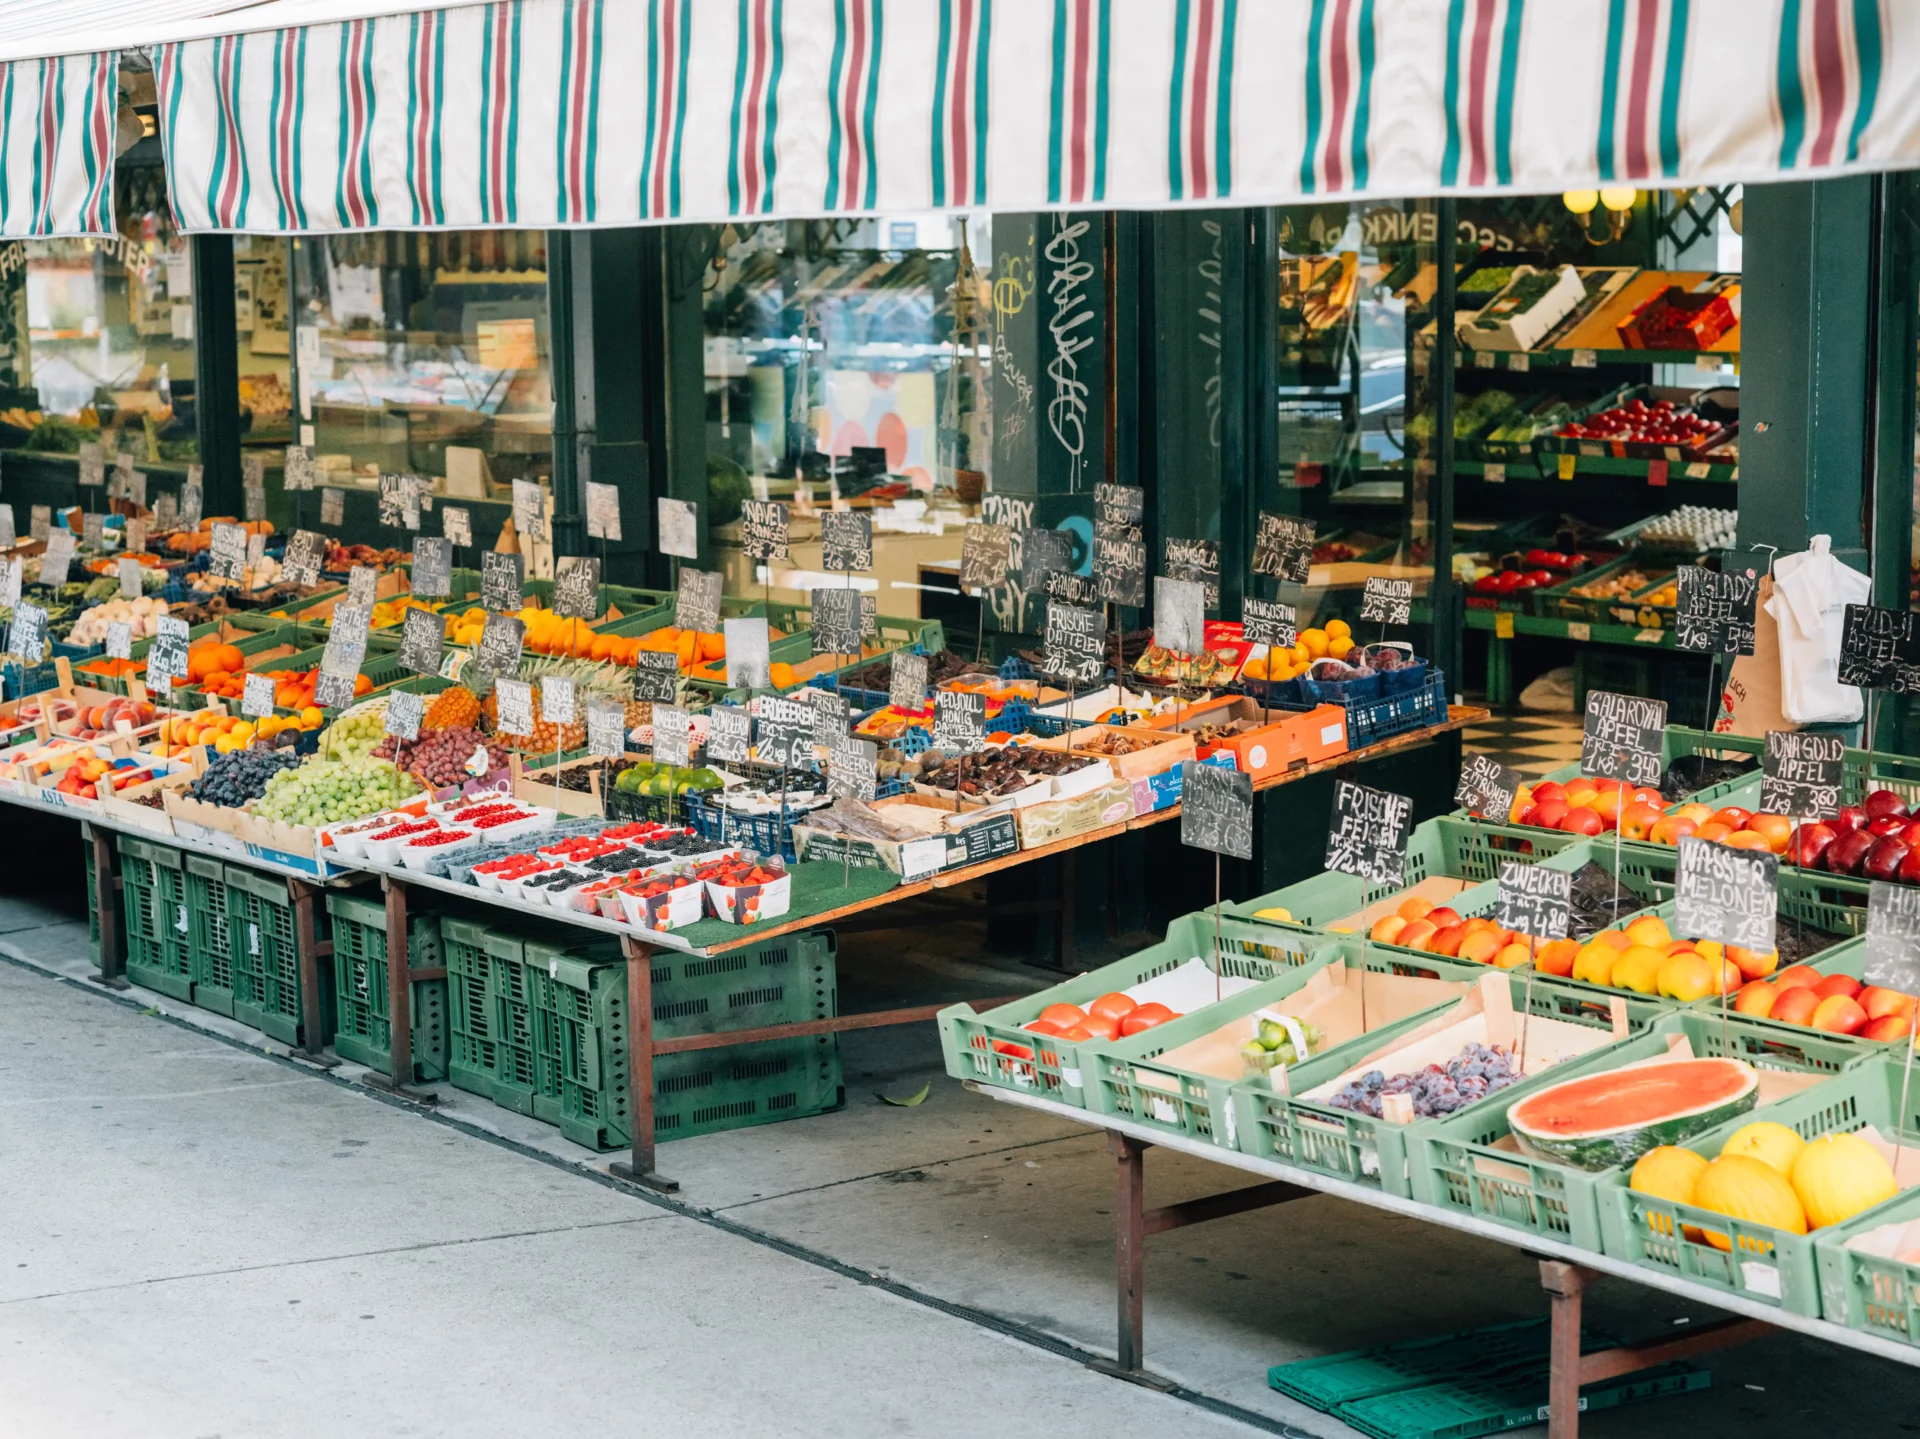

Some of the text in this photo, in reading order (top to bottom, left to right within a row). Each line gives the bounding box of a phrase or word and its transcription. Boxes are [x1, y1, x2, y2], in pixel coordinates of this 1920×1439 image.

[745, 502, 788, 530] NAVEL
[1366, 577, 1413, 598] RINGLOTEN
[1048, 606, 1094, 633] FRISCHE
[1244, 599, 1296, 623] MANGOSTIN
[1046, 627, 1106, 656] DATTELEN
[638, 651, 678, 669] KIRSCHEN
[759, 695, 816, 727] ERDBEEREN
[811, 692, 845, 717] FRISCHE
[941, 709, 973, 726] HONIG
[814, 709, 848, 737] EIGEN
[934, 720, 983, 738] DATTELEN
[829, 747, 878, 778] ERDBEEREN
[1474, 755, 1502, 778] BIO
[1460, 767, 1513, 810] ZITRONEN
[1338, 782, 1409, 830] FRISCHE
[1341, 816, 1399, 850] FEIGEN
[1680, 840, 1772, 889] WASSER
[1501, 861, 1570, 898] ZWECKEN
[1680, 870, 1777, 920] MELONEN
